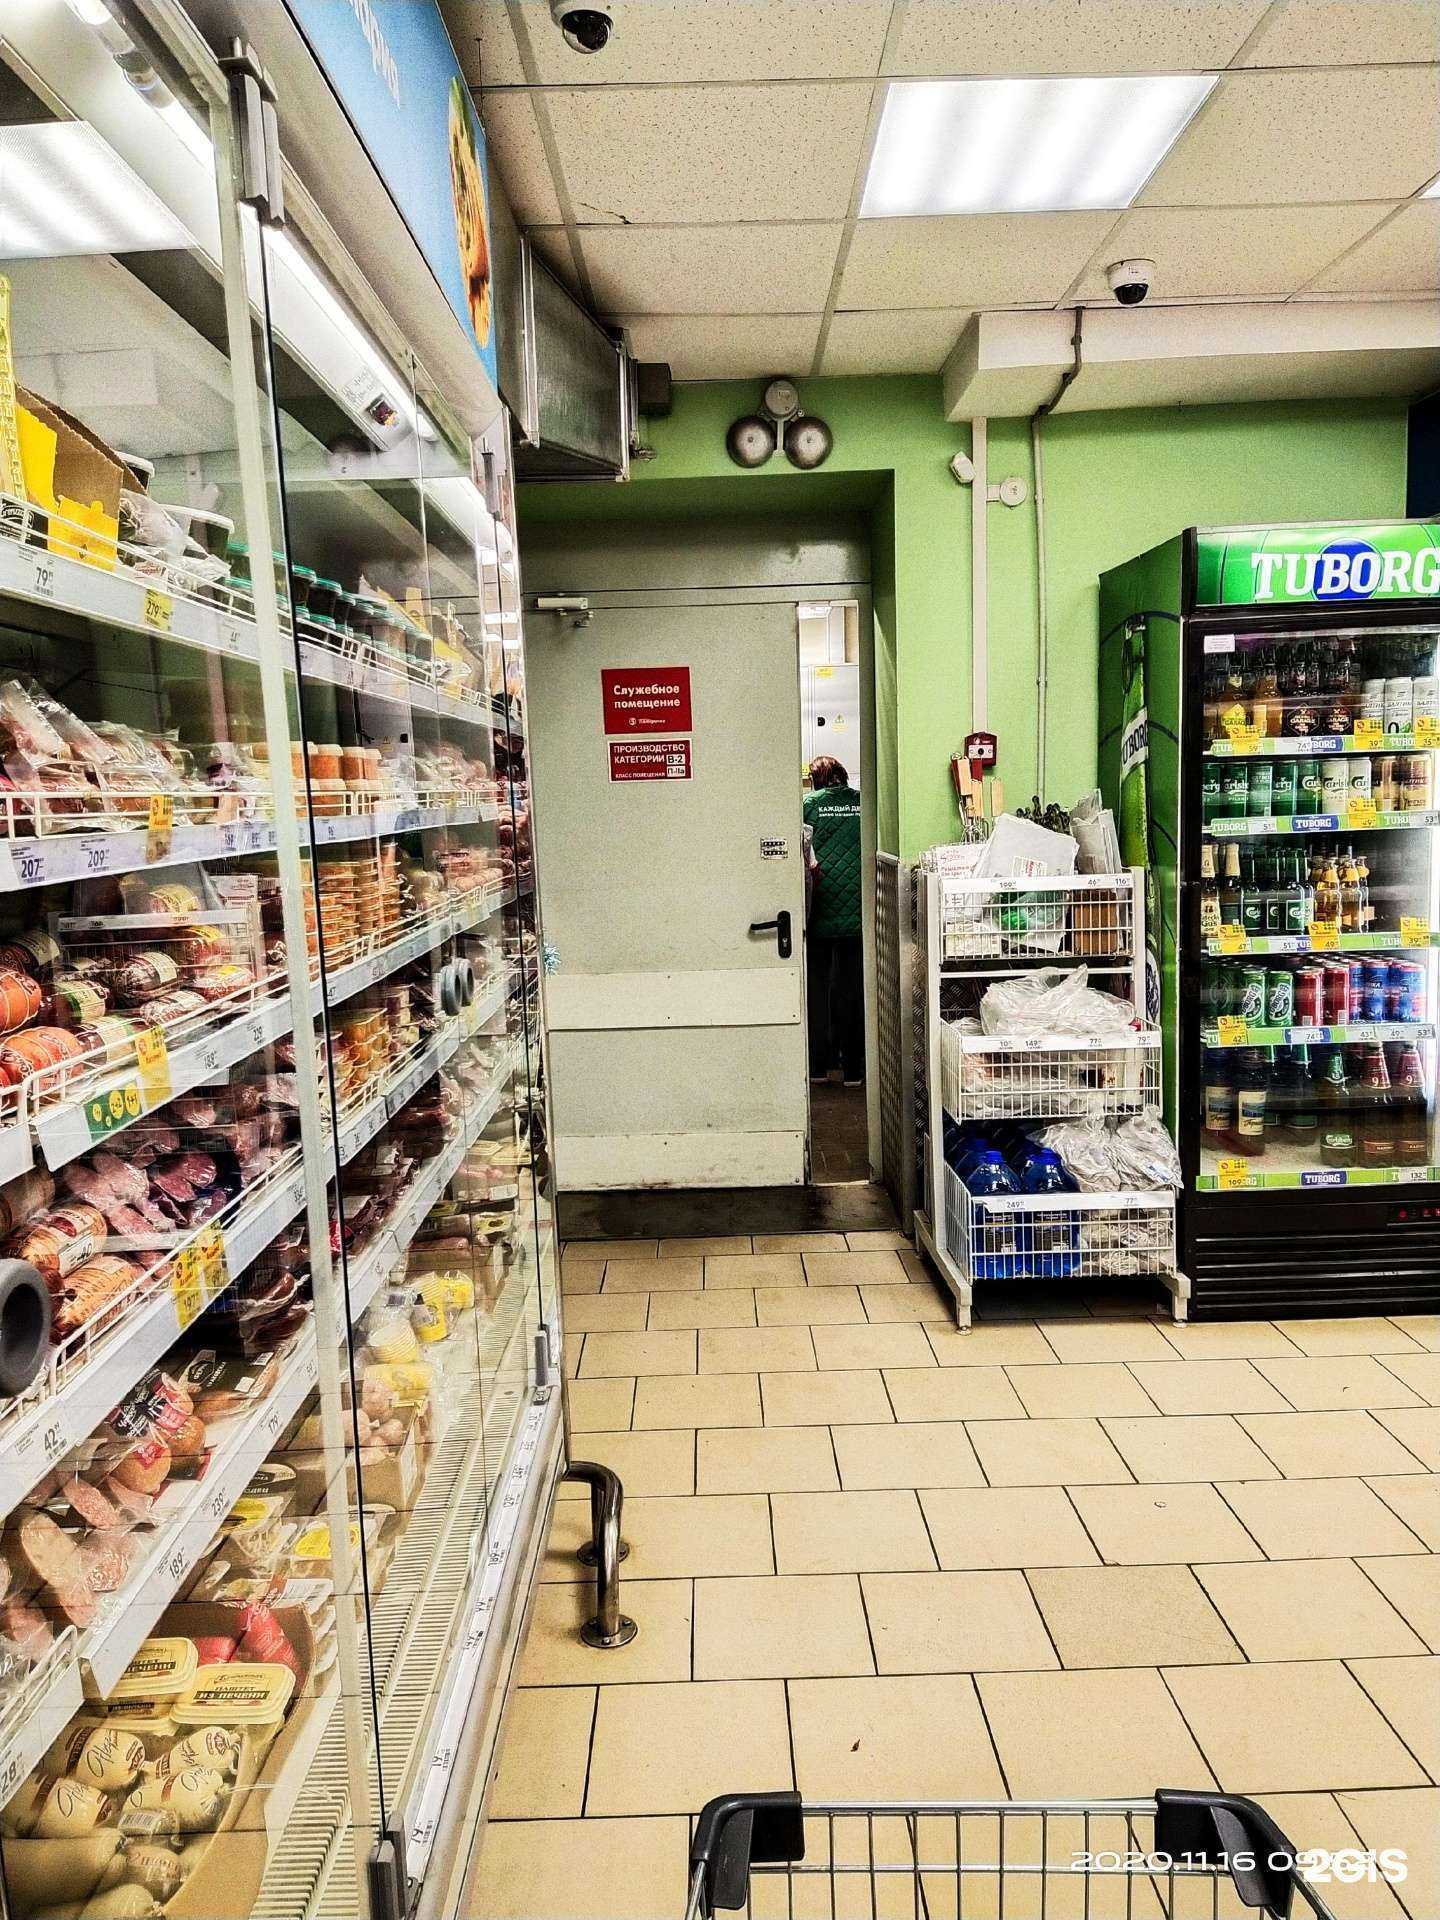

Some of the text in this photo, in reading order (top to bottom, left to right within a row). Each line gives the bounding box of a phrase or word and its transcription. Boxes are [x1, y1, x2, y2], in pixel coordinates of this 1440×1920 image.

[1252, 548, 1440, 600] TUBORG
[613, 684, 680, 697] Служебное
[614, 699, 681, 709] помещение
[613, 743, 685, 753] ПРОИЗВОДСТВО
[614, 754, 665, 764] КАТЕГОРИИ
[819, 804, 851, 813] КАЖДЫЙ
[1295, 818, 1331, 829] TUBORG
[87, 850, 105, 868] 209
[21, 859, 40, 878] 207
[1304, 1173, 1341, 1184] TUBORG
[44, 1428, 58, 1451] 42
[169, 1551, 183, 1579] 189
[199, 1692, 267, 1700] ИЗ ПЕЧЕНИ
